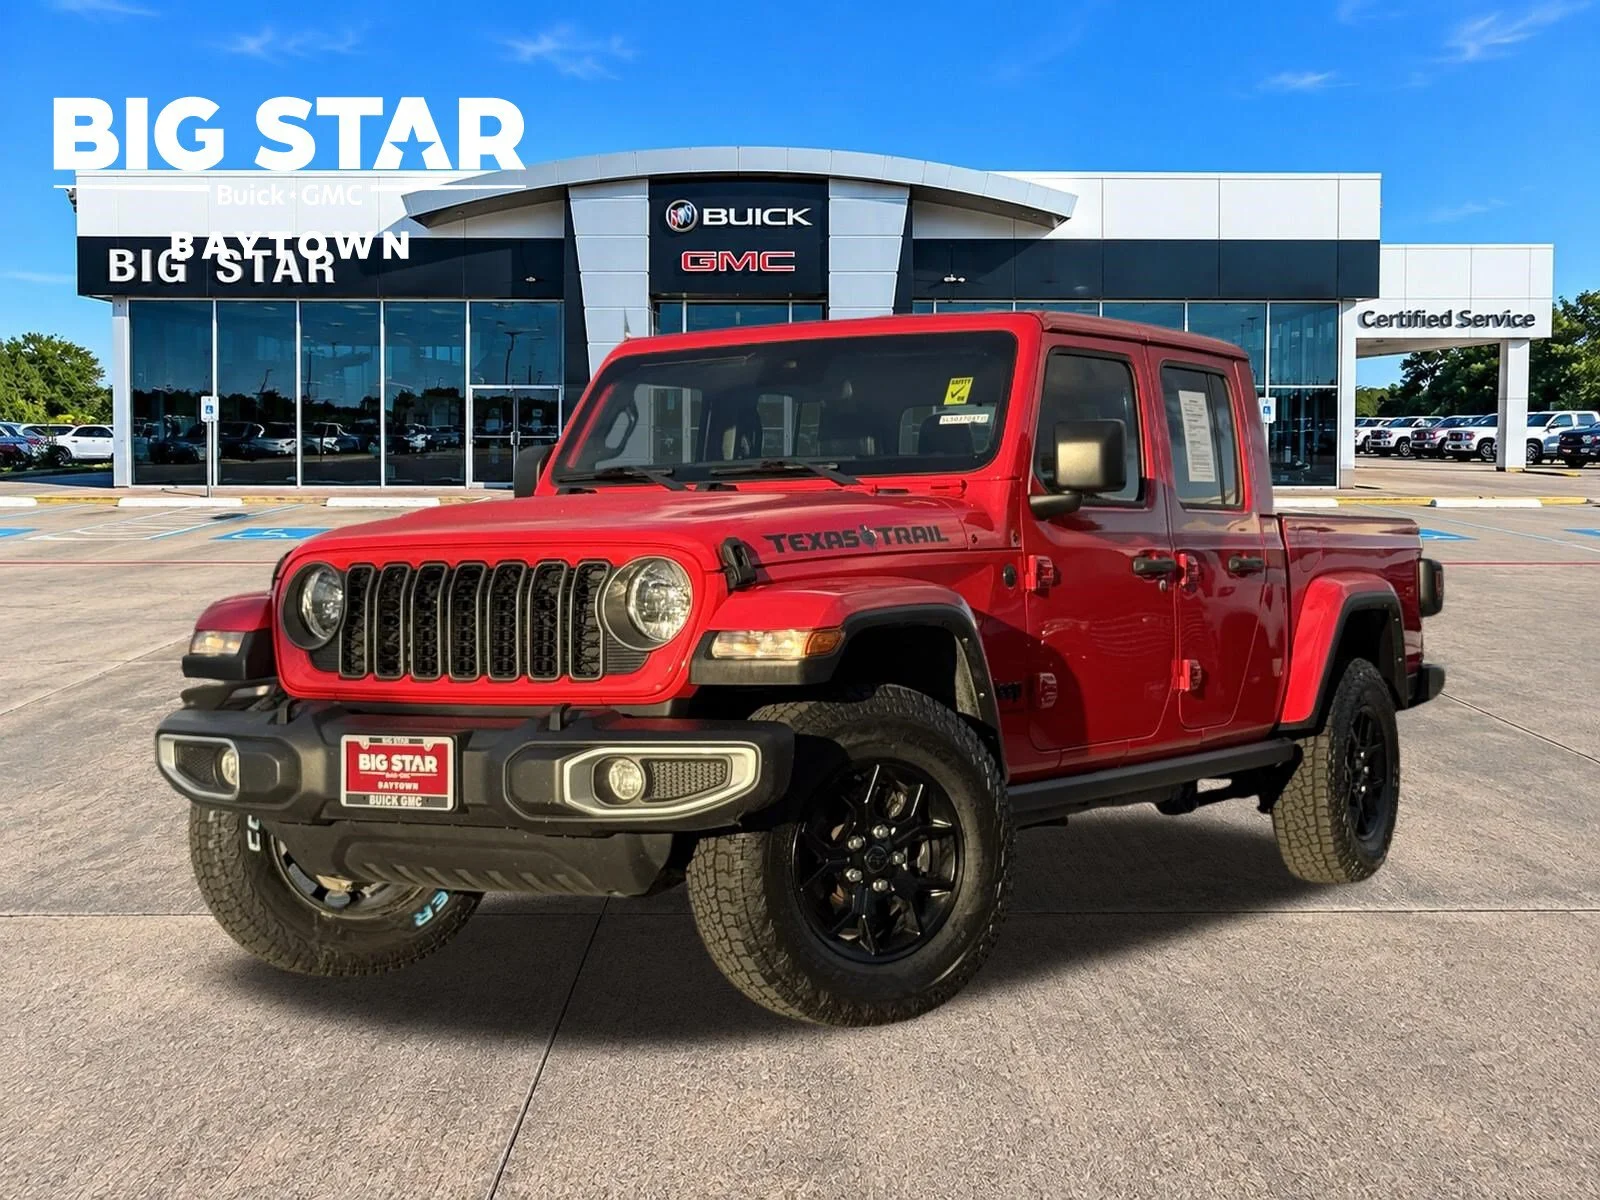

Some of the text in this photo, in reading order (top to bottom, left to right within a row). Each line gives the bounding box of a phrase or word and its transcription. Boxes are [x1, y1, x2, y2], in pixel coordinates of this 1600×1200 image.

[703, 207, 813, 226] BUICK
[108, 248, 335, 283] BIG STAR
[681, 250, 796, 272] GMC
[1359, 309, 1536, 328] Certified Service
[761, 525, 949, 553] TEXAS TRAIL
[358, 753, 438, 772] BIG STAR
[377, 781, 419, 791] BAYTOWN
[369, 795, 423, 807] BUICK GMC
